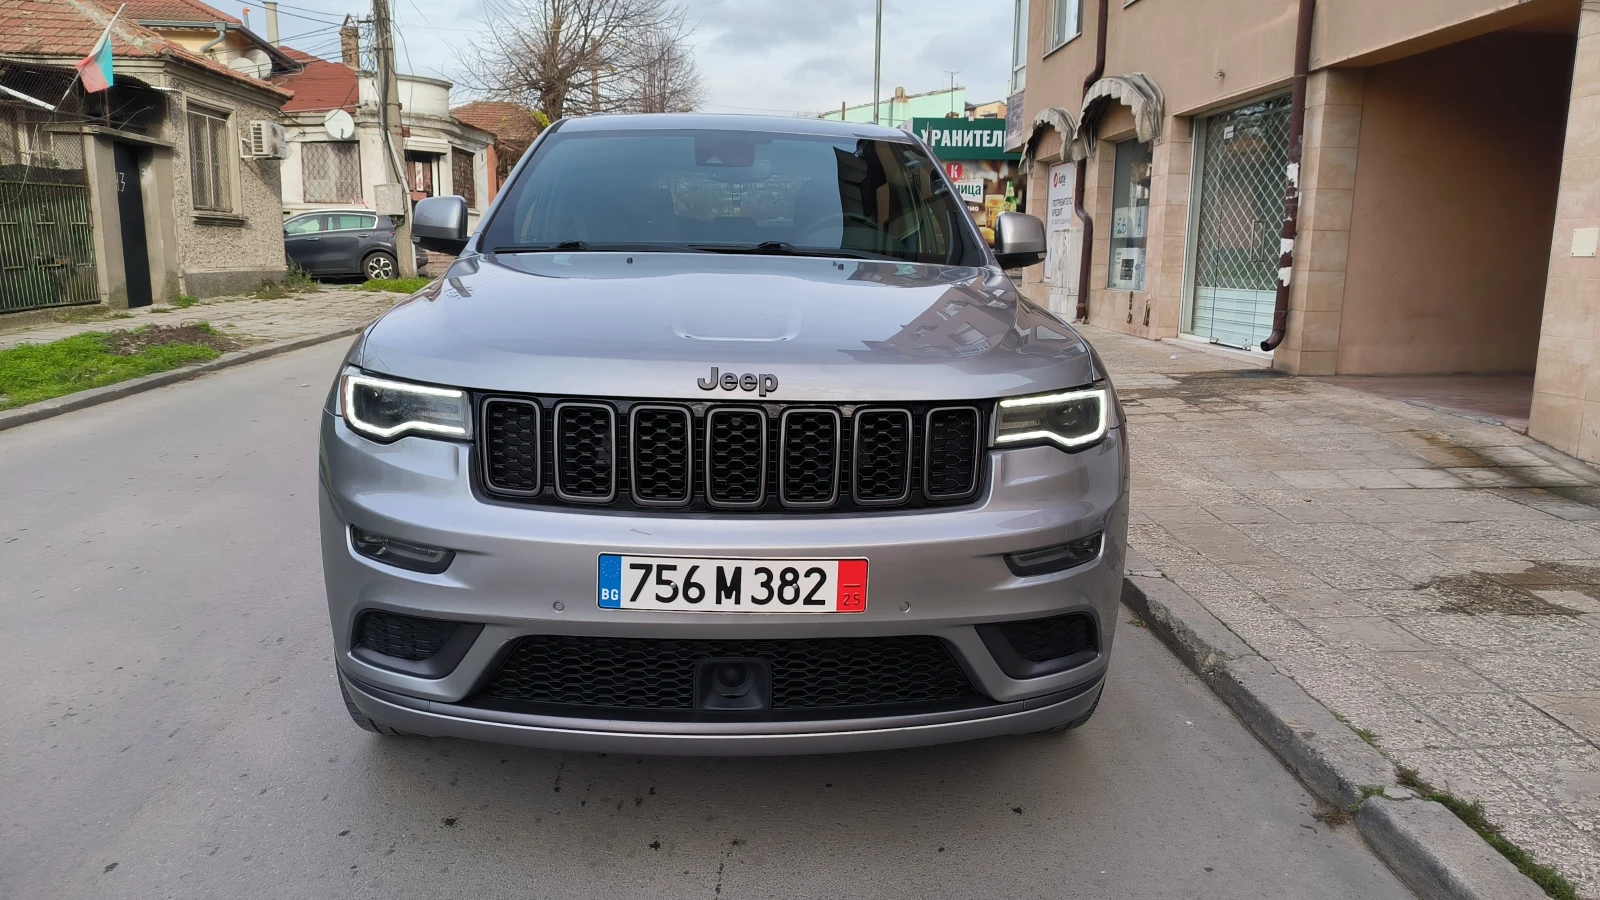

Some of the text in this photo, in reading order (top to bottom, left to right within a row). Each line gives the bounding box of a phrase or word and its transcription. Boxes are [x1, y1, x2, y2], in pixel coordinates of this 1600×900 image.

[921, 129, 1006, 147] ХРАНИТЕЛ
[697, 367, 779, 397] Jeep
[629, 563, 827, 606] 756 M 382
[601, 588, 619, 601] BG
[842, 592, 861, 606] 25
